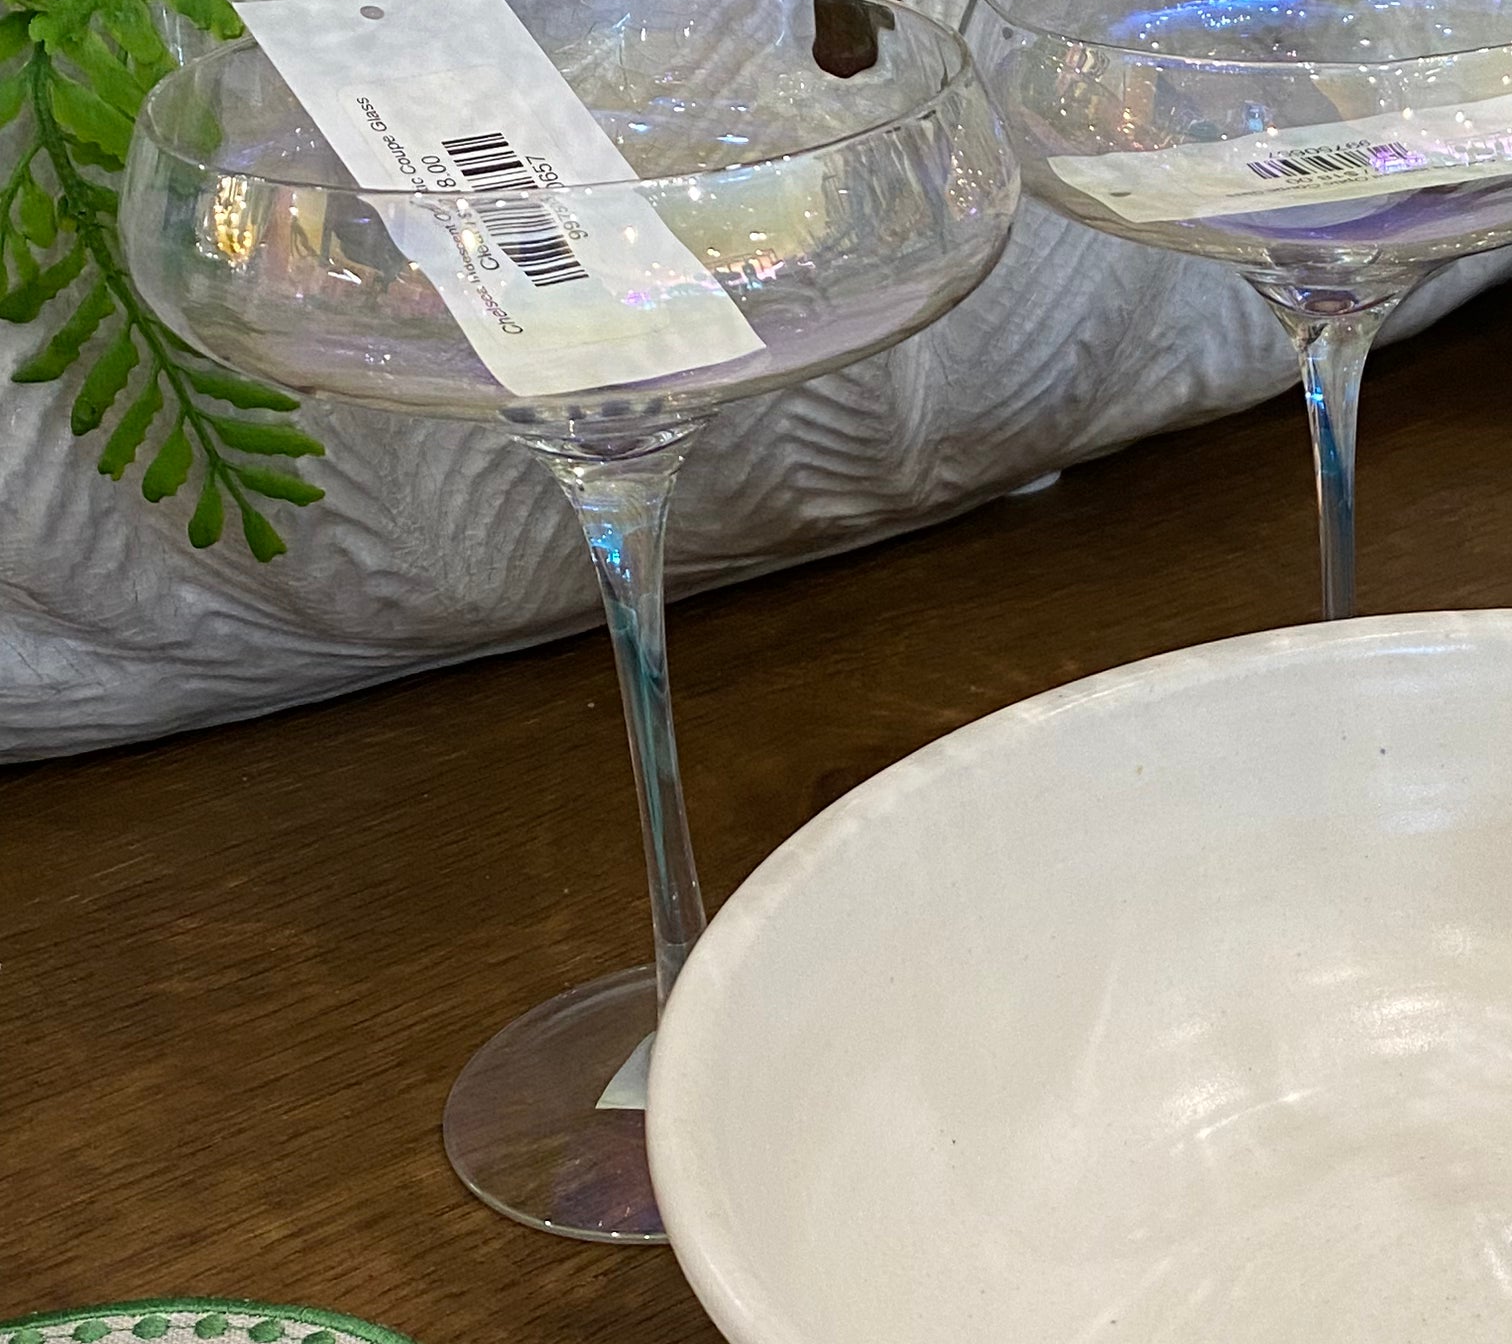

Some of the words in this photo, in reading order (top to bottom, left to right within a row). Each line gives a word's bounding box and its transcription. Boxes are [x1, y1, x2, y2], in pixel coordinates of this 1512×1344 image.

[356, 96, 388, 132] Glass
[382, 134, 417, 175] Coupe
[477, 285, 524, 335] Chelsea
